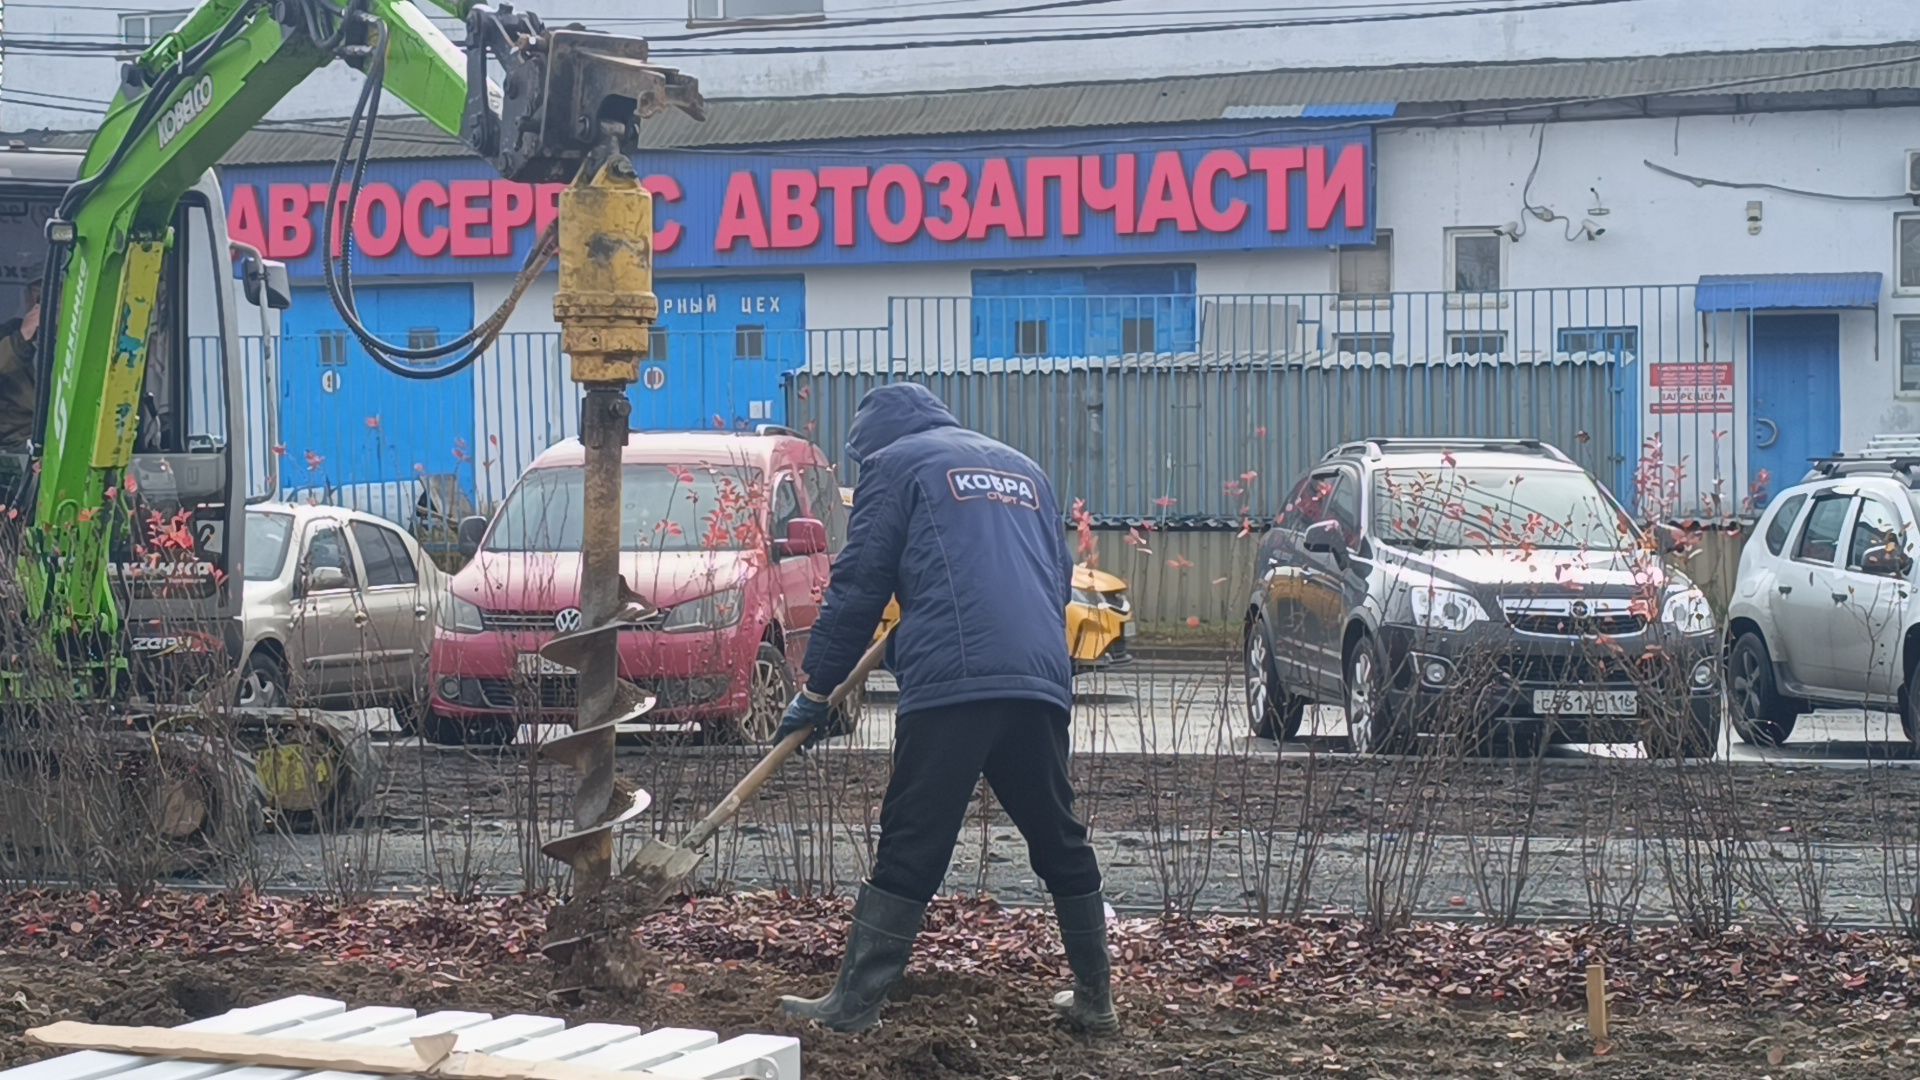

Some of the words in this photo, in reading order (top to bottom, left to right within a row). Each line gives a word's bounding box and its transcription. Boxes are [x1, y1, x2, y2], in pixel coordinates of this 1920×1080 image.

[157, 74, 212, 149] KOBELCO
[227, 174, 682, 258] АВТОСЕРС
[714, 143, 1366, 251] АВТОЗАПЧАСТИ
[664, 293, 717, 314] РНЫЙ
[741, 296, 780, 315] ЦЕХ
[954, 474, 1033, 499] КОБРА
